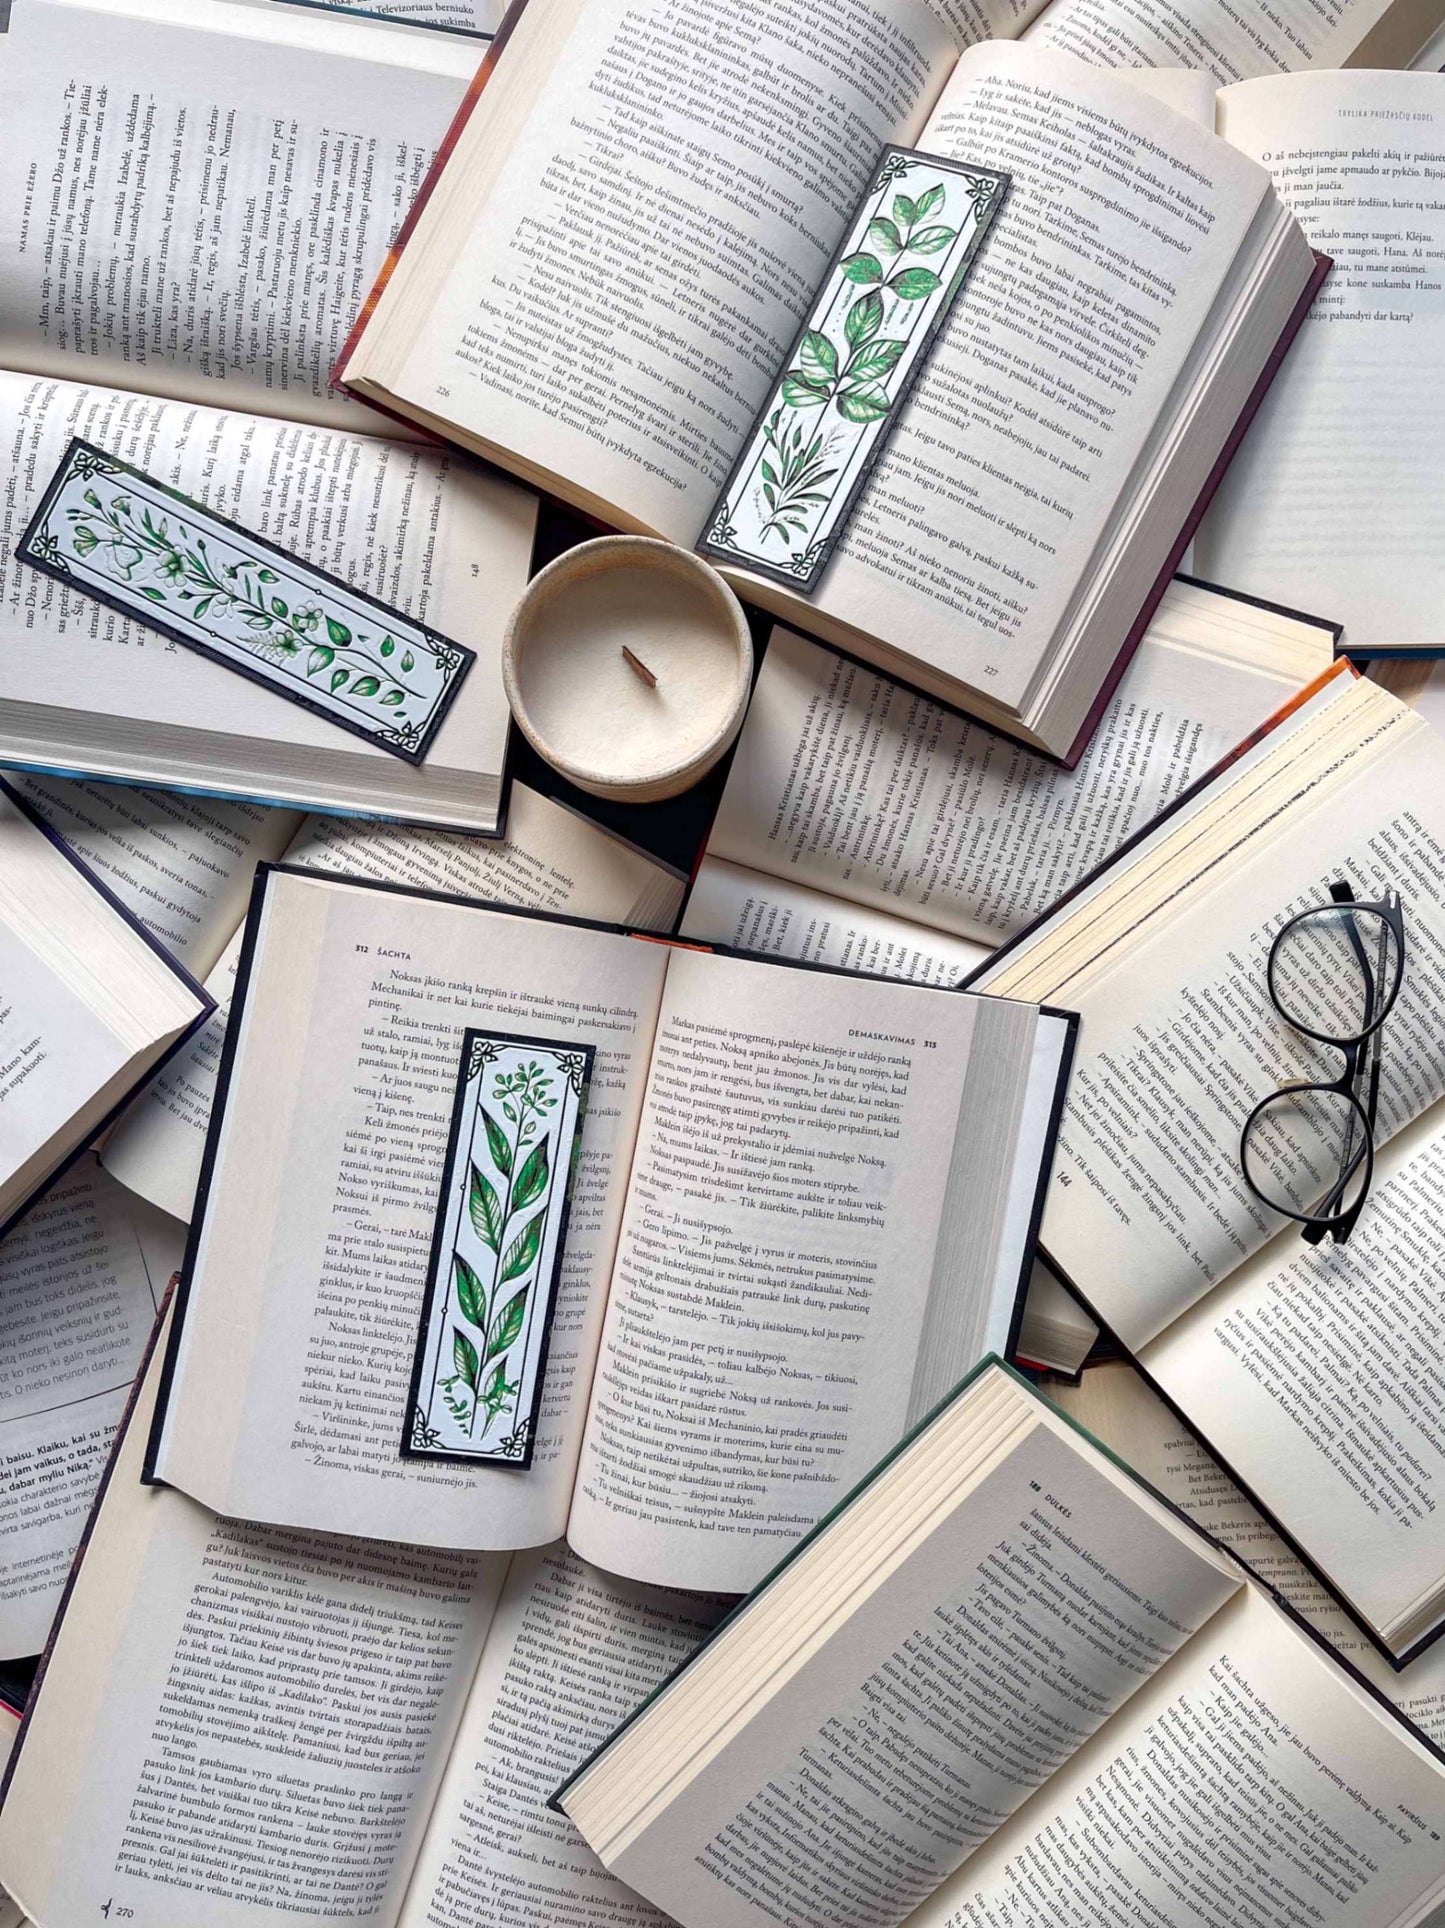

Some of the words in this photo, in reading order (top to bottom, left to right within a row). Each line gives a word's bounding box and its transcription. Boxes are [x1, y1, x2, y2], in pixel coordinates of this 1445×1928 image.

[375, 4, 433, 14] Televizoriaus
[435, 2, 474, 14] berniuko
[1284, 26, 1296, 42] Tuo
[1295, 38, 1312, 60] labiau
[96, 84, 108, 108] elek-
[94, 111, 104, 132] nėra
[91, 135, 101, 161] name
[1261, 152, 1272, 161] O
[1275, 151, 1284, 160] aš
[1288, 148, 1348, 160] nebeįstengiau
[1351, 148, 1380, 160] pakelti
[1383, 149, 1401, 162] akių
[1404, 151, 1411, 160] ir
[26, 162, 37, 192] EŽERO
[82, 164, 97, 191] Tame
[23, 195, 32, 216] PRIE
[78, 195, 95, 235] telefoną.
[19, 219, 29, 253] NAMAS
[1310, 228, 1340, 239] reikalo
[1342, 232, 1369, 241] manęs
[1371, 231, 1403, 243] saugoti,
[1405, 231, 1433, 243] Klėjau.
[77, 238, 86, 267] mano
[71, 270, 84, 304] įkrauti
[491, 274, 506, 289] kus.
[508, 283, 522, 295] Du
[523, 291, 560, 314] vaikučius.
[561, 309, 574, 319] Ar
[574, 316, 614, 338] supranti?
[1329, 310, 1371, 322] pabandyti
[1373, 310, 1387, 320] dar
[1389, 311, 1414, 323] kartą?
[71, 308, 84, 353] paprašyti
[87, 326, 97, 335] ir
[90, 337, 98, 355] tros
[436, 385, 450, 397] 226
[455, 349, 483, 365] aukos?
[482, 360, 501, 375] Kiek
[502, 368, 523, 385] laiko
[522, 381, 536, 391] jos
[536, 387, 561, 404] turėjo
[560, 400, 608, 427] pasirengti?
[886, 448, 911, 463] mano
[912, 456, 945, 479] klientas
[945, 476, 979, 498] meluoja.
[375, 544, 388, 596] susiruošėt?
[471, 563, 479, 577] 148
[836, 545, 855, 557] savo
[855, 553, 897, 577] advokatui
[897, 573, 905, 581] ir
[906, 577, 933, 596] tikram
[934, 592, 964, 613] anūkui,
[965, 607, 977, 618] tai
[977, 614, 998, 630] tegul
[998, 626, 1015, 637] uos-
[983, 664, 999, 676] 227
[834, 734, 853, 768] žvilgsnį.
[831, 768, 841, 779] jo
[822, 779, 838, 815] pagauna
[812, 816, 827, 845] sustoja,
[77, 845, 93, 857] apie
[92, 852, 110, 869] šiuos
[110, 865, 138, 889] žodžius,
[138, 885, 167, 904] paskui
[165, 901, 201, 923] gydytoja
[138, 916, 187, 945] automobilio
[355, 944, 369, 953] 312
[377, 946, 411, 960] ŠACHTA
[367, 997, 402, 1012] pintinę.
[848, 1029, 915, 1045] DEMASKAVIMAS
[1132, 1023, 1150, 1042] juos
[1147, 1040, 1178, 1075] išprašyti.
[0, 1056, 21, 1079] Mano
[19, 1036, 41, 1056] kam-
[8, 1051, 47, 1088] supakuoti.
[353, 1085, 376, 1099] vieną
[377, 1088, 382, 1099] į
[384, 1089, 414, 1104] kišenę.
[1076, 1068, 1091, 1085] Kur
[1086, 1083, 1099, 1097] jis,
[1096, 1095, 1109, 1107] po
[1108, 1106, 1138, 1138] velniais?
[1097, 1052, 1129, 1085] prileisite
[1126, 1084, 1138, 1097] čia
[1136, 1096, 1159, 1124] smėlio,
[1159, 1121, 1180, 1147] liksite
[1178, 1145, 1204, 1176] skolingi
[672, 1154, 712, 1169] paspaudė.
[712, 1161, 725, 1173] Jis
[726, 1167, 770, 1182] susižavėjo
[772, 1172, 789, 1183] šios
[791, 1177, 821, 1188] moters
[822, 1181, 860, 1194] stiprybe.
[1056, 1171, 1072, 1187] 144
[1213, 1327, 1240, 1356] vargusi.
[1240, 1354, 1264, 1382] Vylėsi,
[1262, 1379, 1280, 1398] kad
[1276, 1395, 1304, 1426] Markas
[1302, 1425, 1333, 1459] neišvyko
[1331, 1457, 1341, 1467] iš
[1337, 1465, 1361, 1491] miesto
[1359, 1488, 1370, 1502] be
[1366, 1499, 1380, 1515] jos.
[5, 1451, 35, 1464] baisu.
[36, 1441, 69, 1455] Klaiku,
[71, 1433, 86, 1444] kai
[89, 1430, 100, 1439] su
[103, 1425, 118, 1435] žm
[8, 1478, 35, 1491] dabar
[38, 1469, 64, 1483] myliu
[1044, 1494, 1072, 1518] DULKĖS
[1019, 1521, 1032, 1531] sai
[1029, 1528, 1052, 1551] didėja.
[201, 1557, 242, 1572] pastatyti
[243, 1563, 261, 1575] kur
[261, 1570, 282, 1580] nors
[283, 1572, 307, 1586] kitur.
[974, 1582, 988, 1595] Jis
[984, 1593, 1012, 1614] pagavo
[1011, 1609, 1042, 1639] Turmano
[510, 1687, 518, 1697] ir
[519, 1691, 528, 1703] tą
[528, 1696, 551, 1711] pačią
[552, 1704, 589, 1724] akimirką
[590, 1716, 615, 1730] durys
[1208, 1664, 1224, 1683] kad
[1220, 1682, 1237, 1701] man
[1234, 1700, 1261, 1727] padėjo
[1260, 1727, 1277, 1746] Ana.
[151, 1732, 170, 1742] nuo
[171, 1734, 198, 1749] lango.
[115, 1907, 134, 1918] 270
